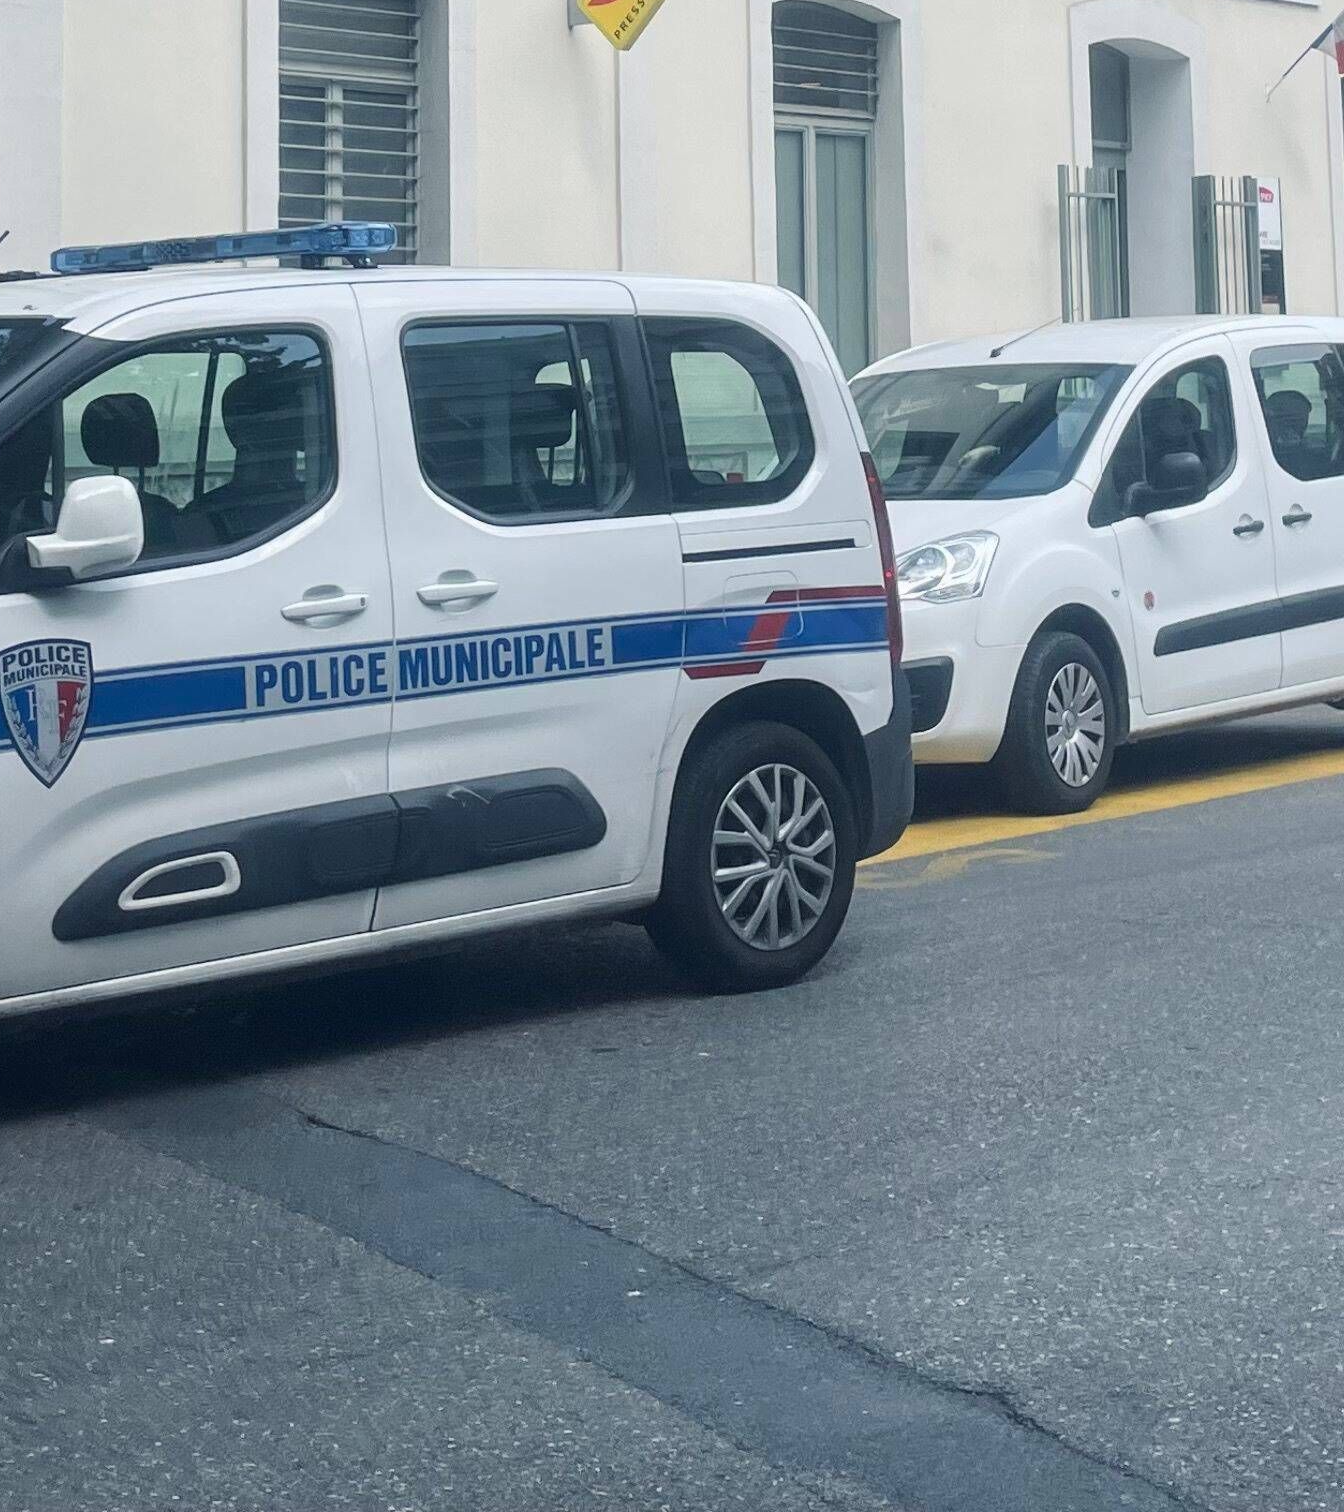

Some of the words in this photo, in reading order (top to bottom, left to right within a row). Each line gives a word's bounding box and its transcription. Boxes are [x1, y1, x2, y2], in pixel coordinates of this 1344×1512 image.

[2, 644, 87, 673] POLICE
[256, 651, 388, 707] POLICE
[398, 627, 605, 690] MUNICIPALE
[3, 663, 88, 688] MUNICIPALE
